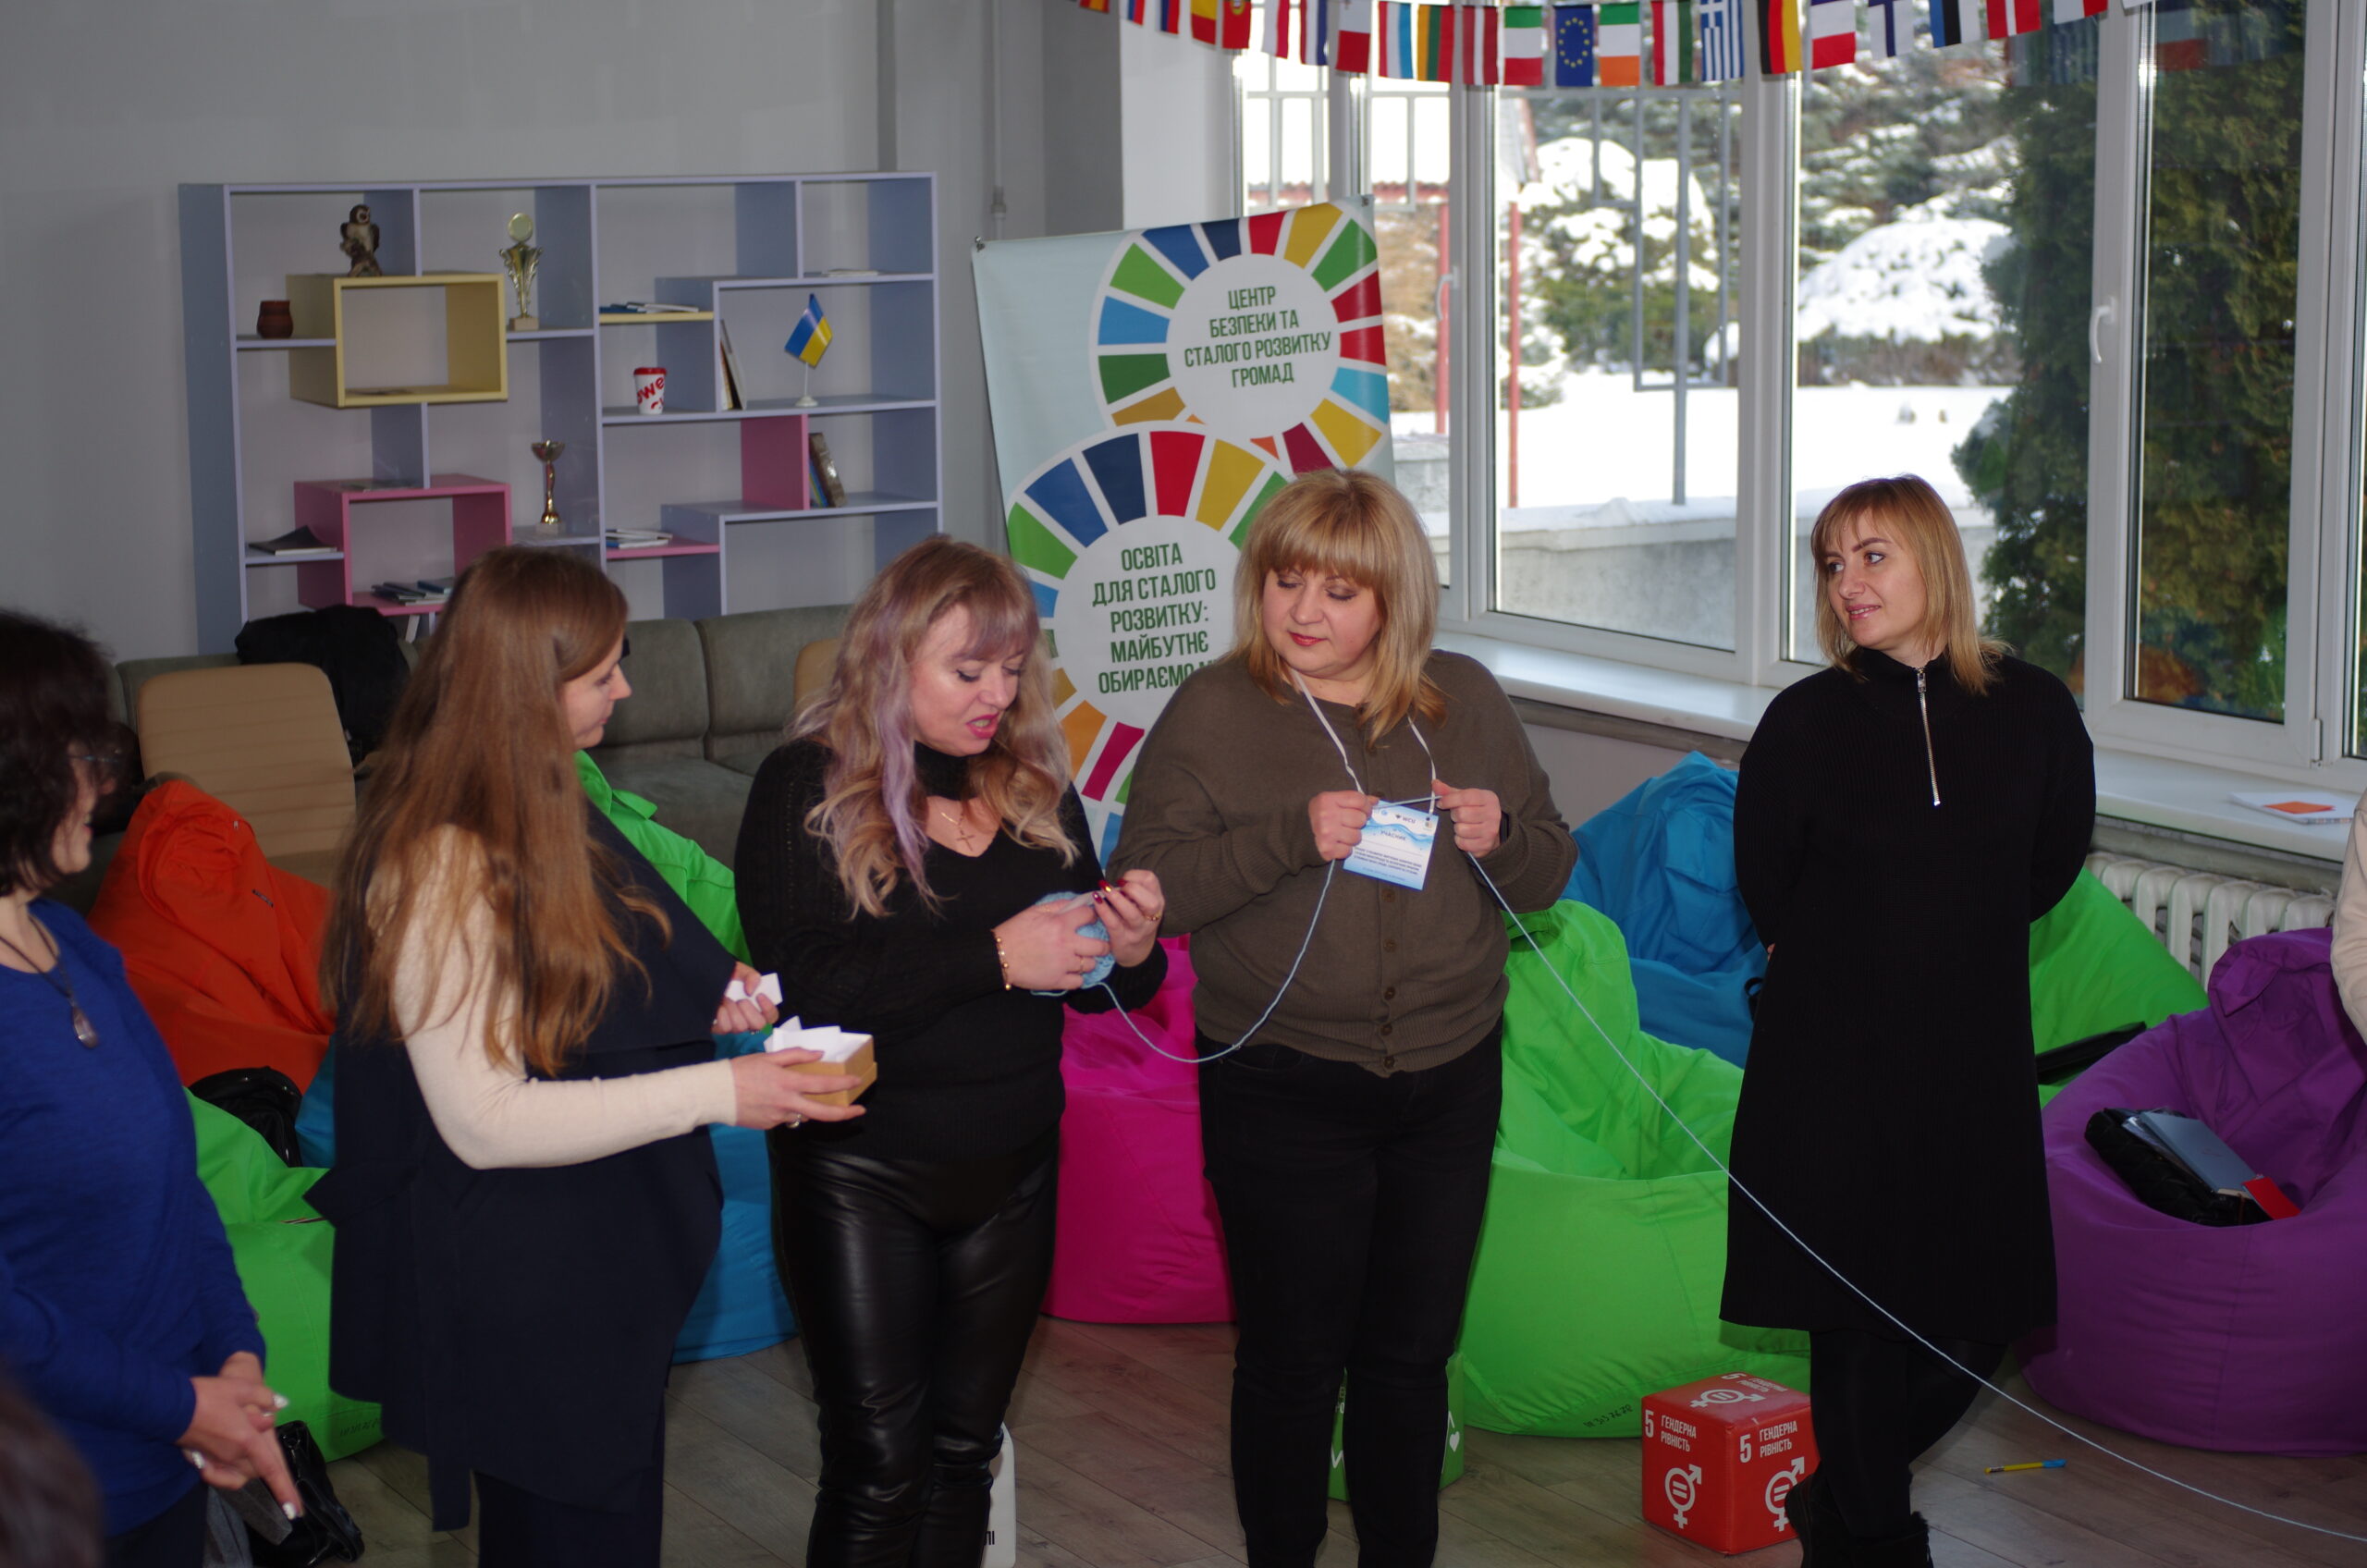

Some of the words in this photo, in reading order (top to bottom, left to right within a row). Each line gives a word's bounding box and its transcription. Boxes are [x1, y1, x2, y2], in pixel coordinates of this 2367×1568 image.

[1228, 286, 1276, 311] ЦЕНТР
[1209, 312, 1277, 338] БЕЗПЕКИ
[1280, 310, 1300, 329] ТА
[1184, 341, 1252, 368] СТАЛОГО
[1255, 331, 1331, 360] РОЗВИТКУ
[1232, 362, 1294, 388] ГРОМАД
[1121, 543, 1183, 571] ОСВІТА
[1092, 579, 1134, 607] ДЛЯ
[1137, 569, 1216, 600] СТАЛОГО
[1110, 600, 1209, 633] РОЗВИТКУ:
[1110, 631, 1209, 663] МАЙБУТНЄ
[1645, 1409, 1654, 1439] 5
[1661, 1415, 1698, 1439] ГЕНДЕРНА
[1760, 1420, 1798, 1443] ГЕНДЕРНА
[1661, 1430, 1691, 1452] РІВНІСТЬ
[1739, 1434, 1751, 1464] 5
[1760, 1438, 1793, 1458] РІВНІСТЬ
